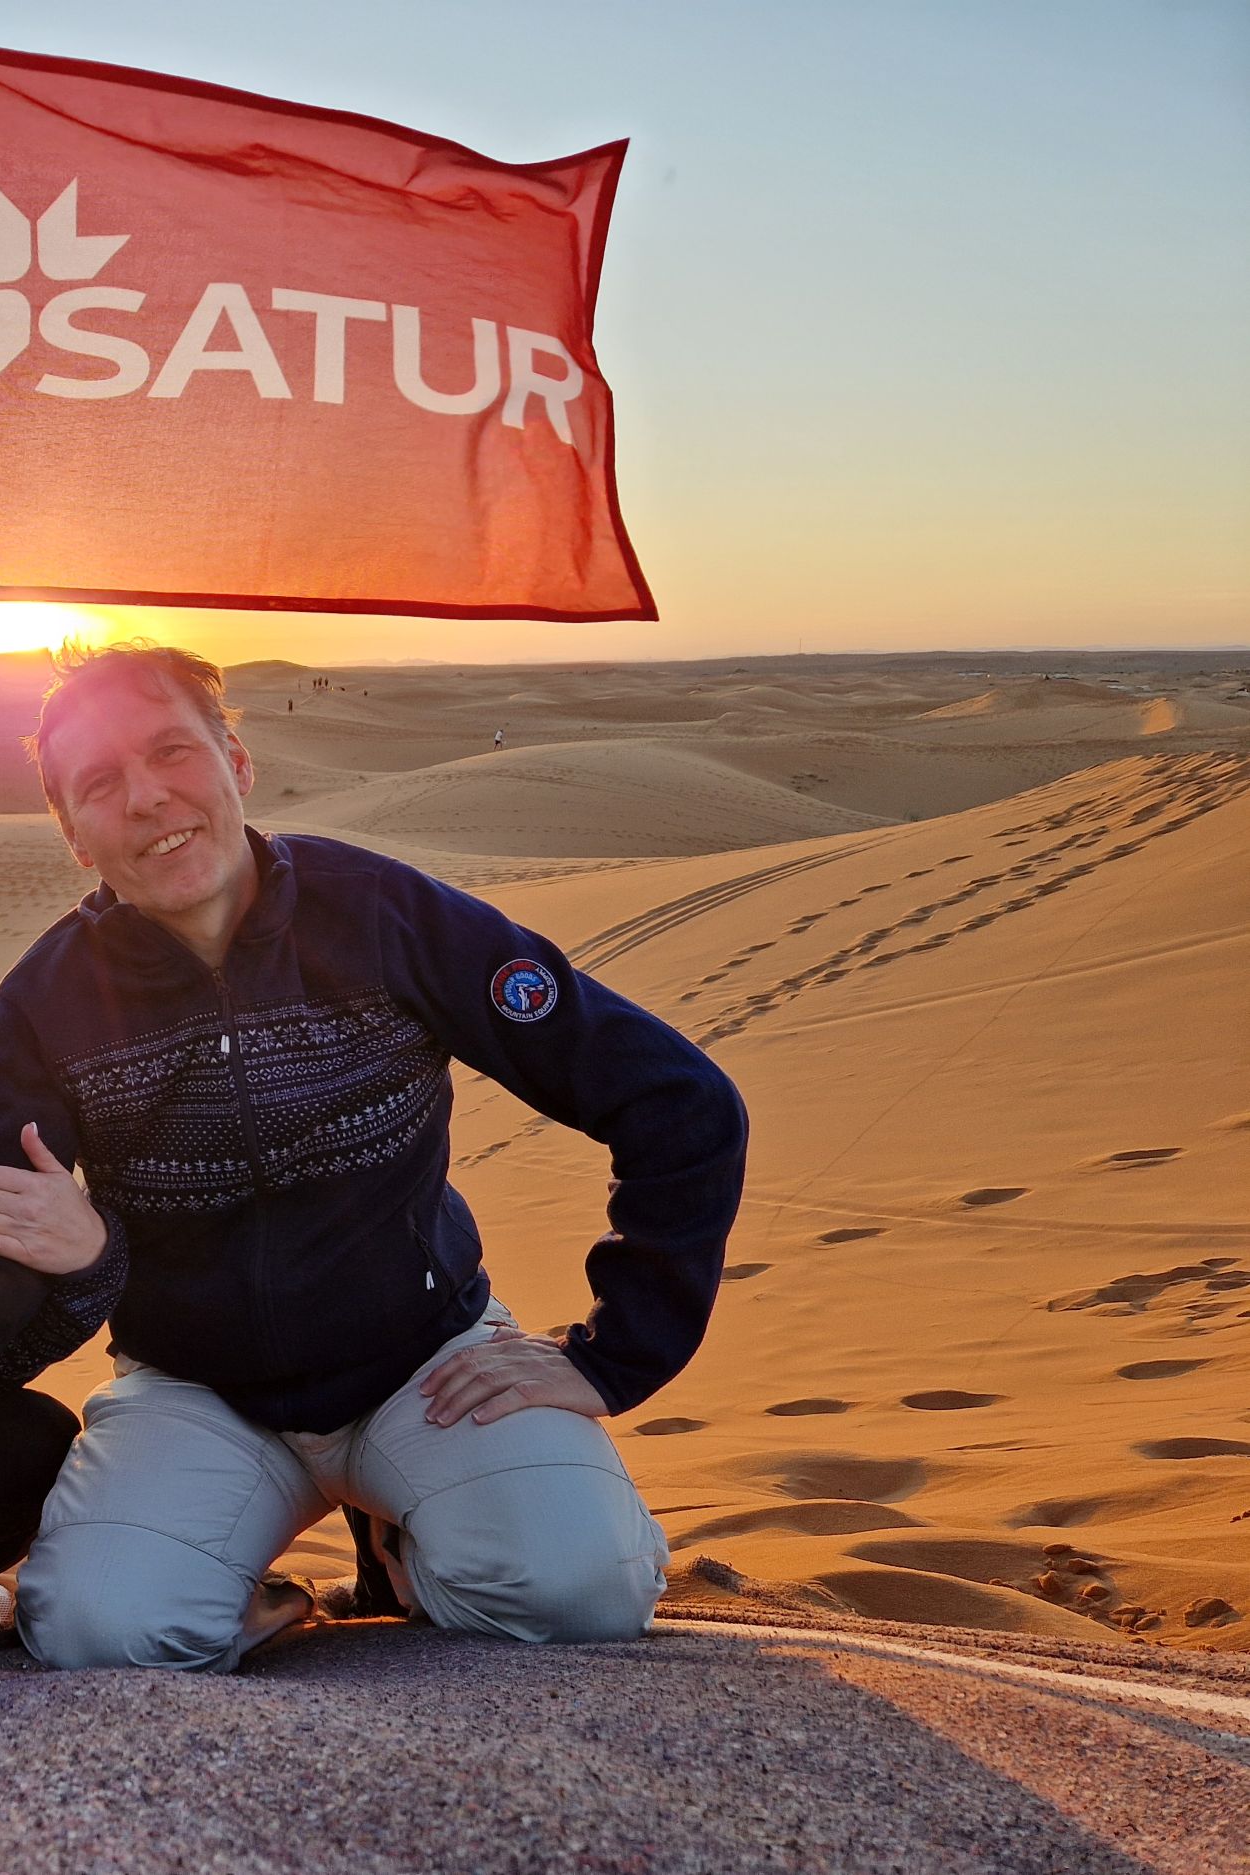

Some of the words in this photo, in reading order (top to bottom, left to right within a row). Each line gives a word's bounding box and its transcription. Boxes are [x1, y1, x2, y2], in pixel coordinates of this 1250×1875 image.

[36, 283, 583, 446] SATUR
[535, 966, 553, 986] SUPPLY
[501, 1004, 534, 1019] MOUNTAIN
[533, 987, 555, 1017] EQUIPMENT
